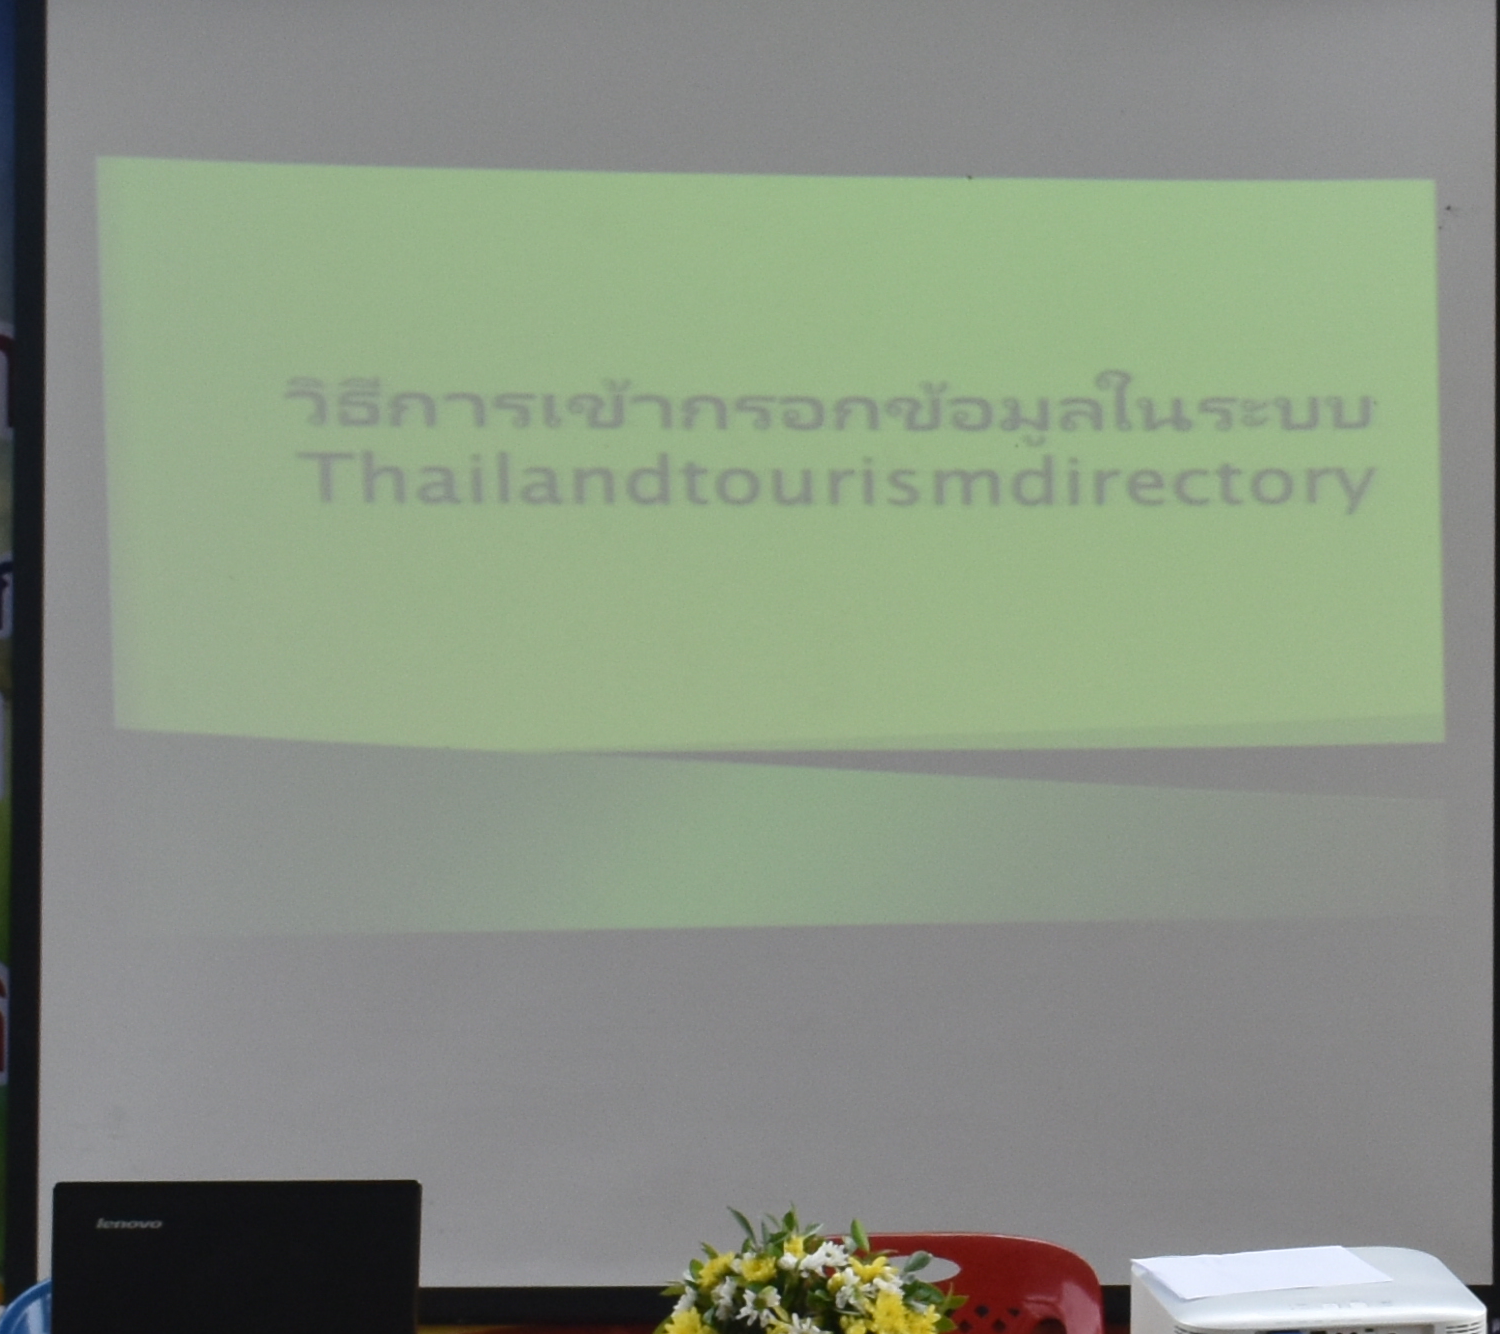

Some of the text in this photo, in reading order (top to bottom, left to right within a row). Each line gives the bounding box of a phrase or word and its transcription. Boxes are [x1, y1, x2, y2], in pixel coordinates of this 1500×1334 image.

[280, 369, 1380, 449] วิธีการเข้ากรอกข้อมูลในระบบ
[298, 449, 1380, 515] Thailandtourismdirectory
[95, 1216, 163, 1230] lenovo
